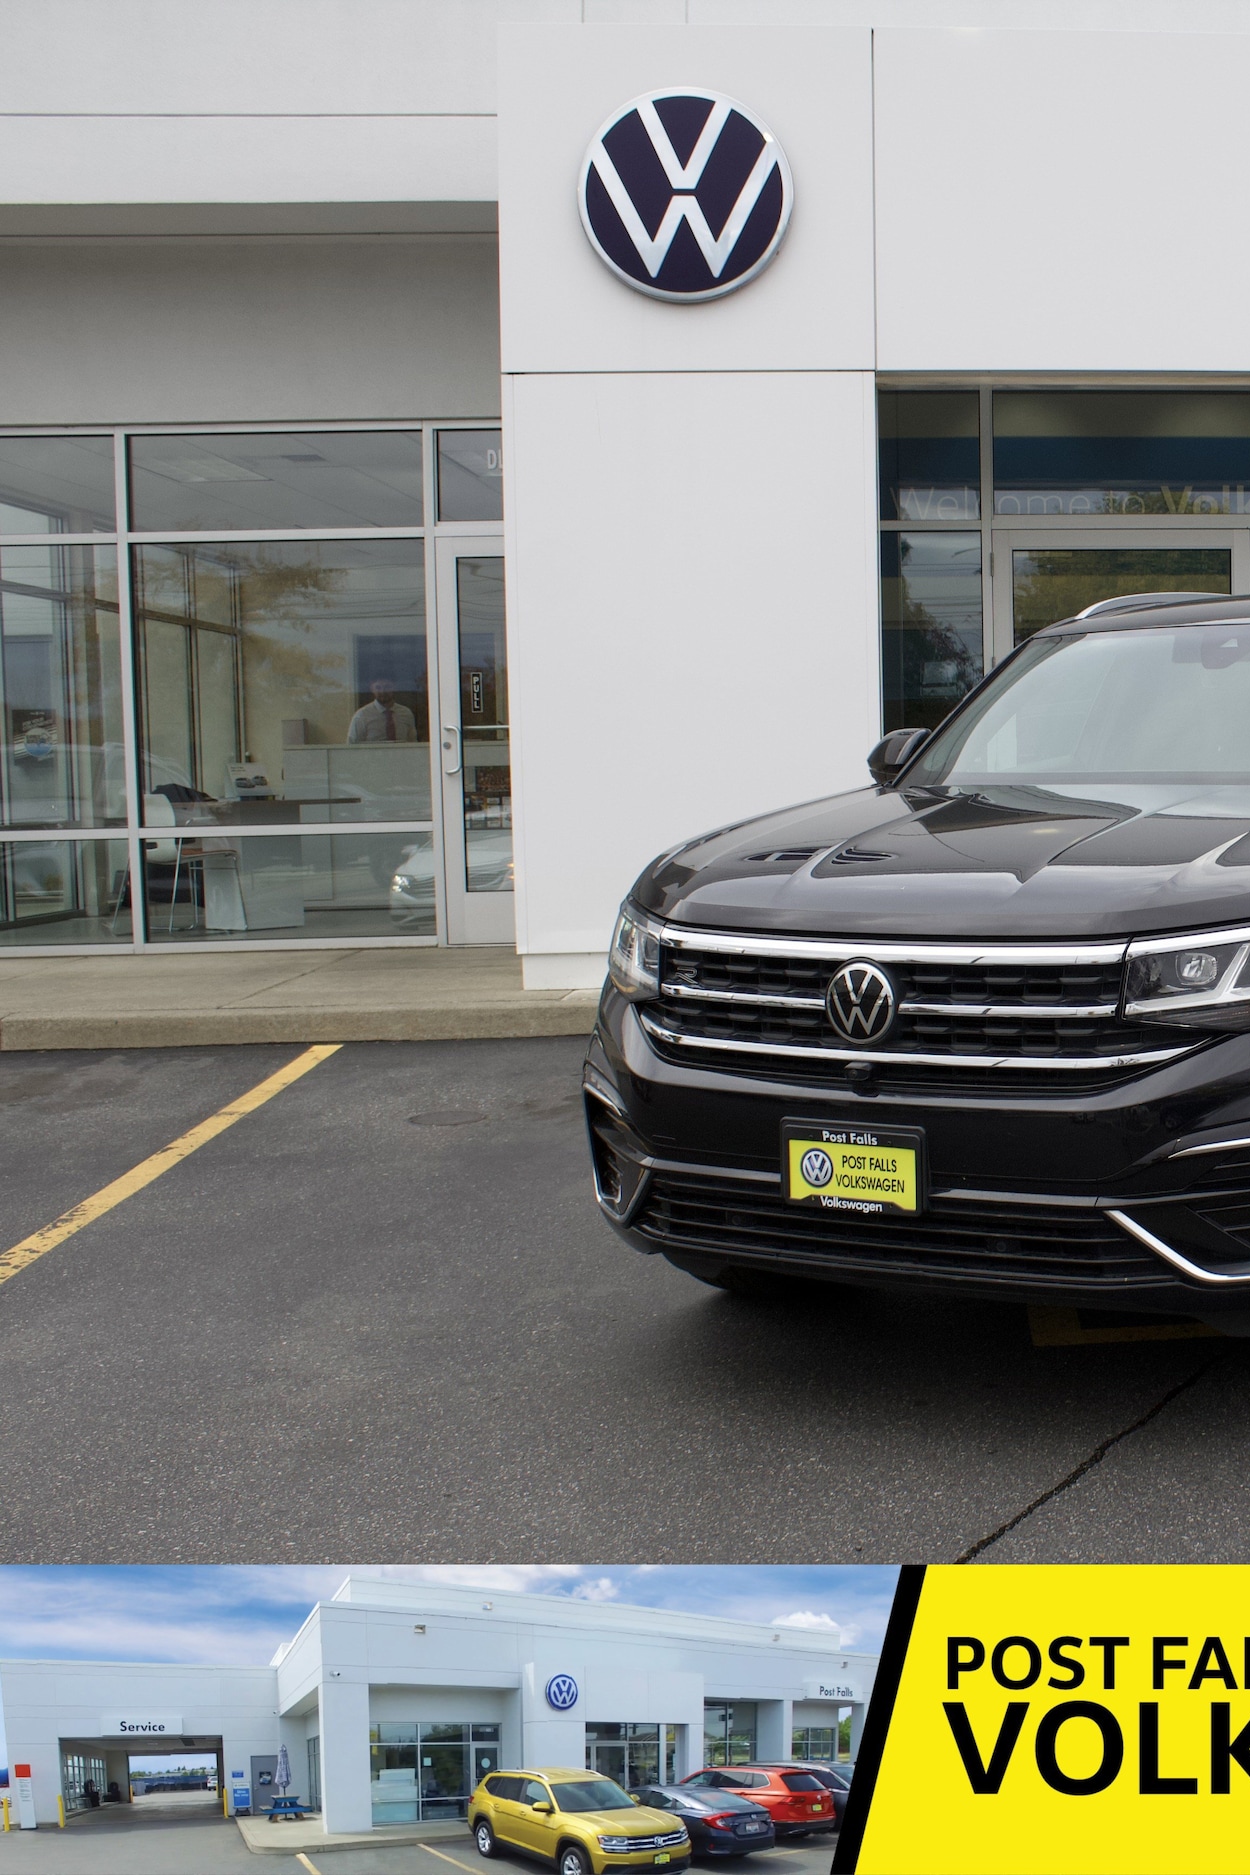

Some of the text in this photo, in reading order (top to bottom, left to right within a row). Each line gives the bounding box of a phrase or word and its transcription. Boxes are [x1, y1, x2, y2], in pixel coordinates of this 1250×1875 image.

[580, 89, 791, 298] VW
[889, 486, 1091, 520] Welome
[472, 676, 480, 709] PULL
[828, 963, 893, 1041] VW
[822, 1130, 878, 1146] Post Falls
[802, 1150, 833, 1187] VW
[842, 1155, 897, 1173] POST FALLS
[835, 1174, 905, 1194] VOLKSWAGEN
[820, 1195, 883, 1213] Volkswagen
